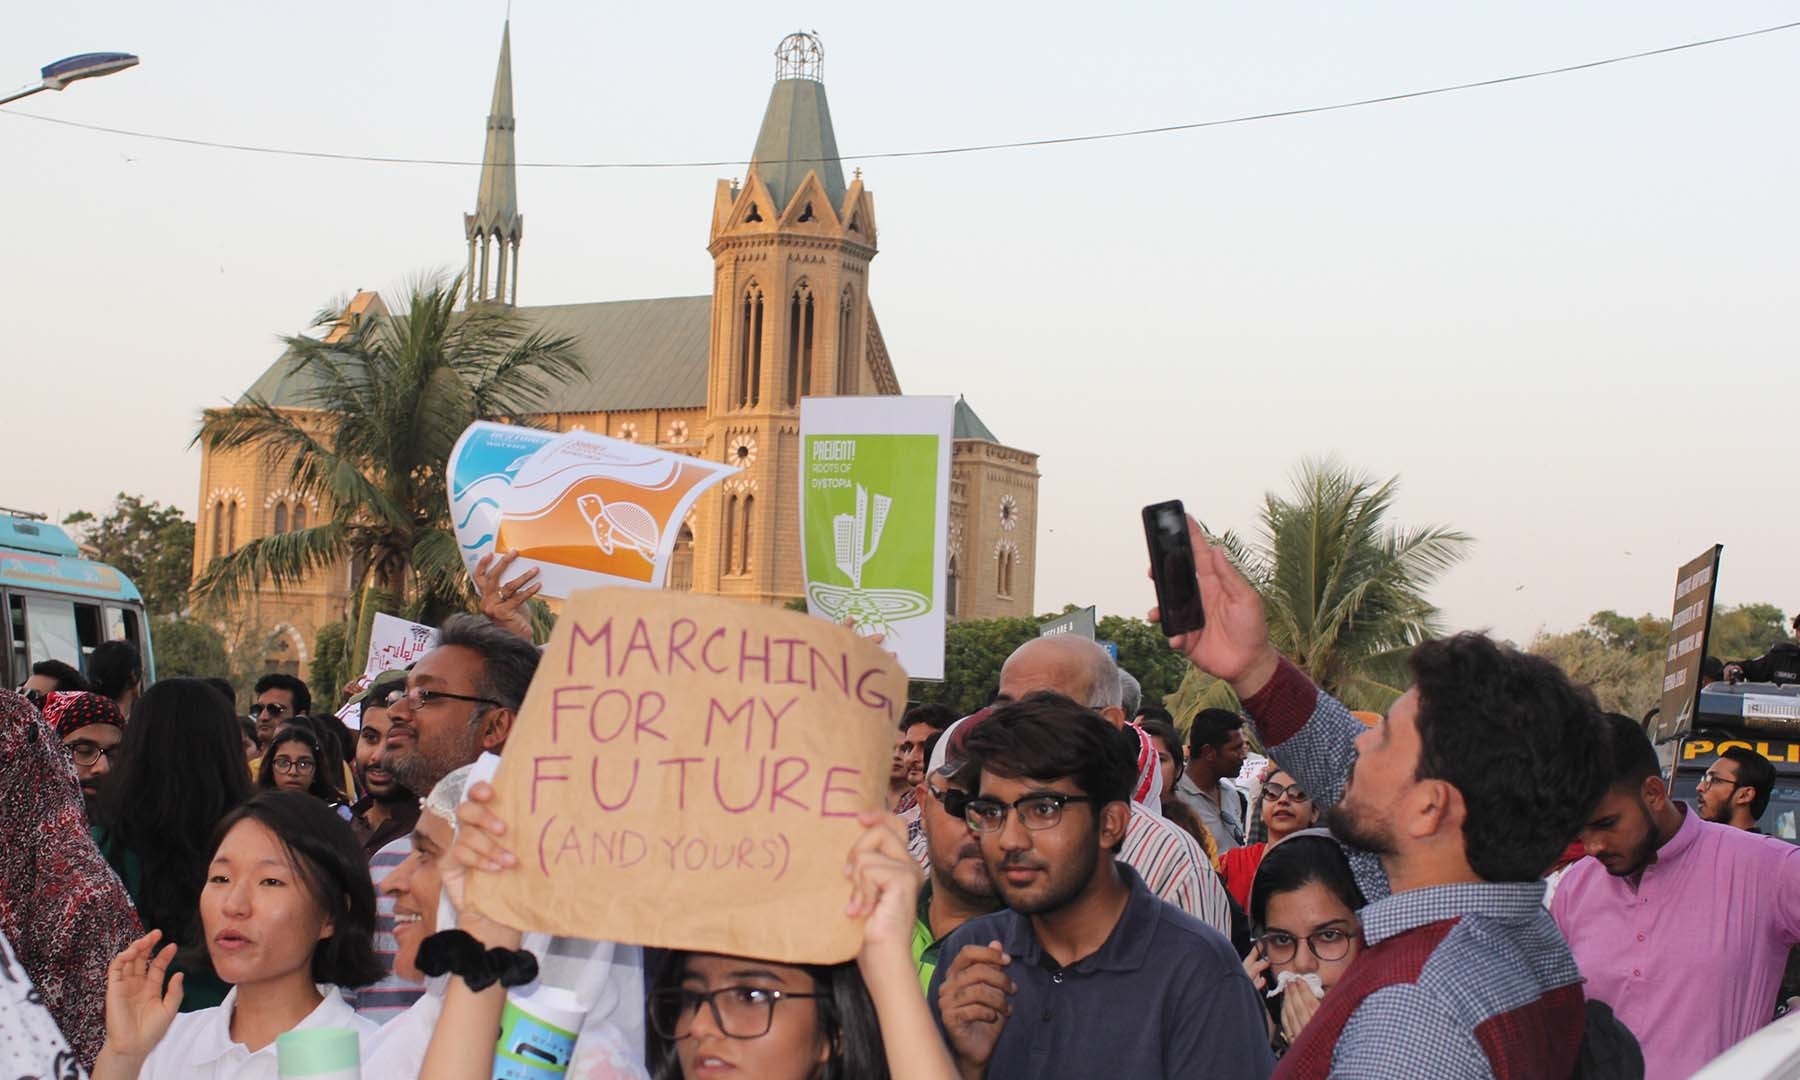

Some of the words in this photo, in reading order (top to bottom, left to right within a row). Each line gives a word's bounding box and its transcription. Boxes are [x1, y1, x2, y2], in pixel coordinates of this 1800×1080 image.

[567, 616, 894, 720] MARCHING
[551, 685, 668, 745] FOR
[704, 696, 799, 752] MY
[529, 755, 862, 818] FUTURE
[537, 815, 648, 878] (AND
[664, 832, 792, 881] YOURS)
